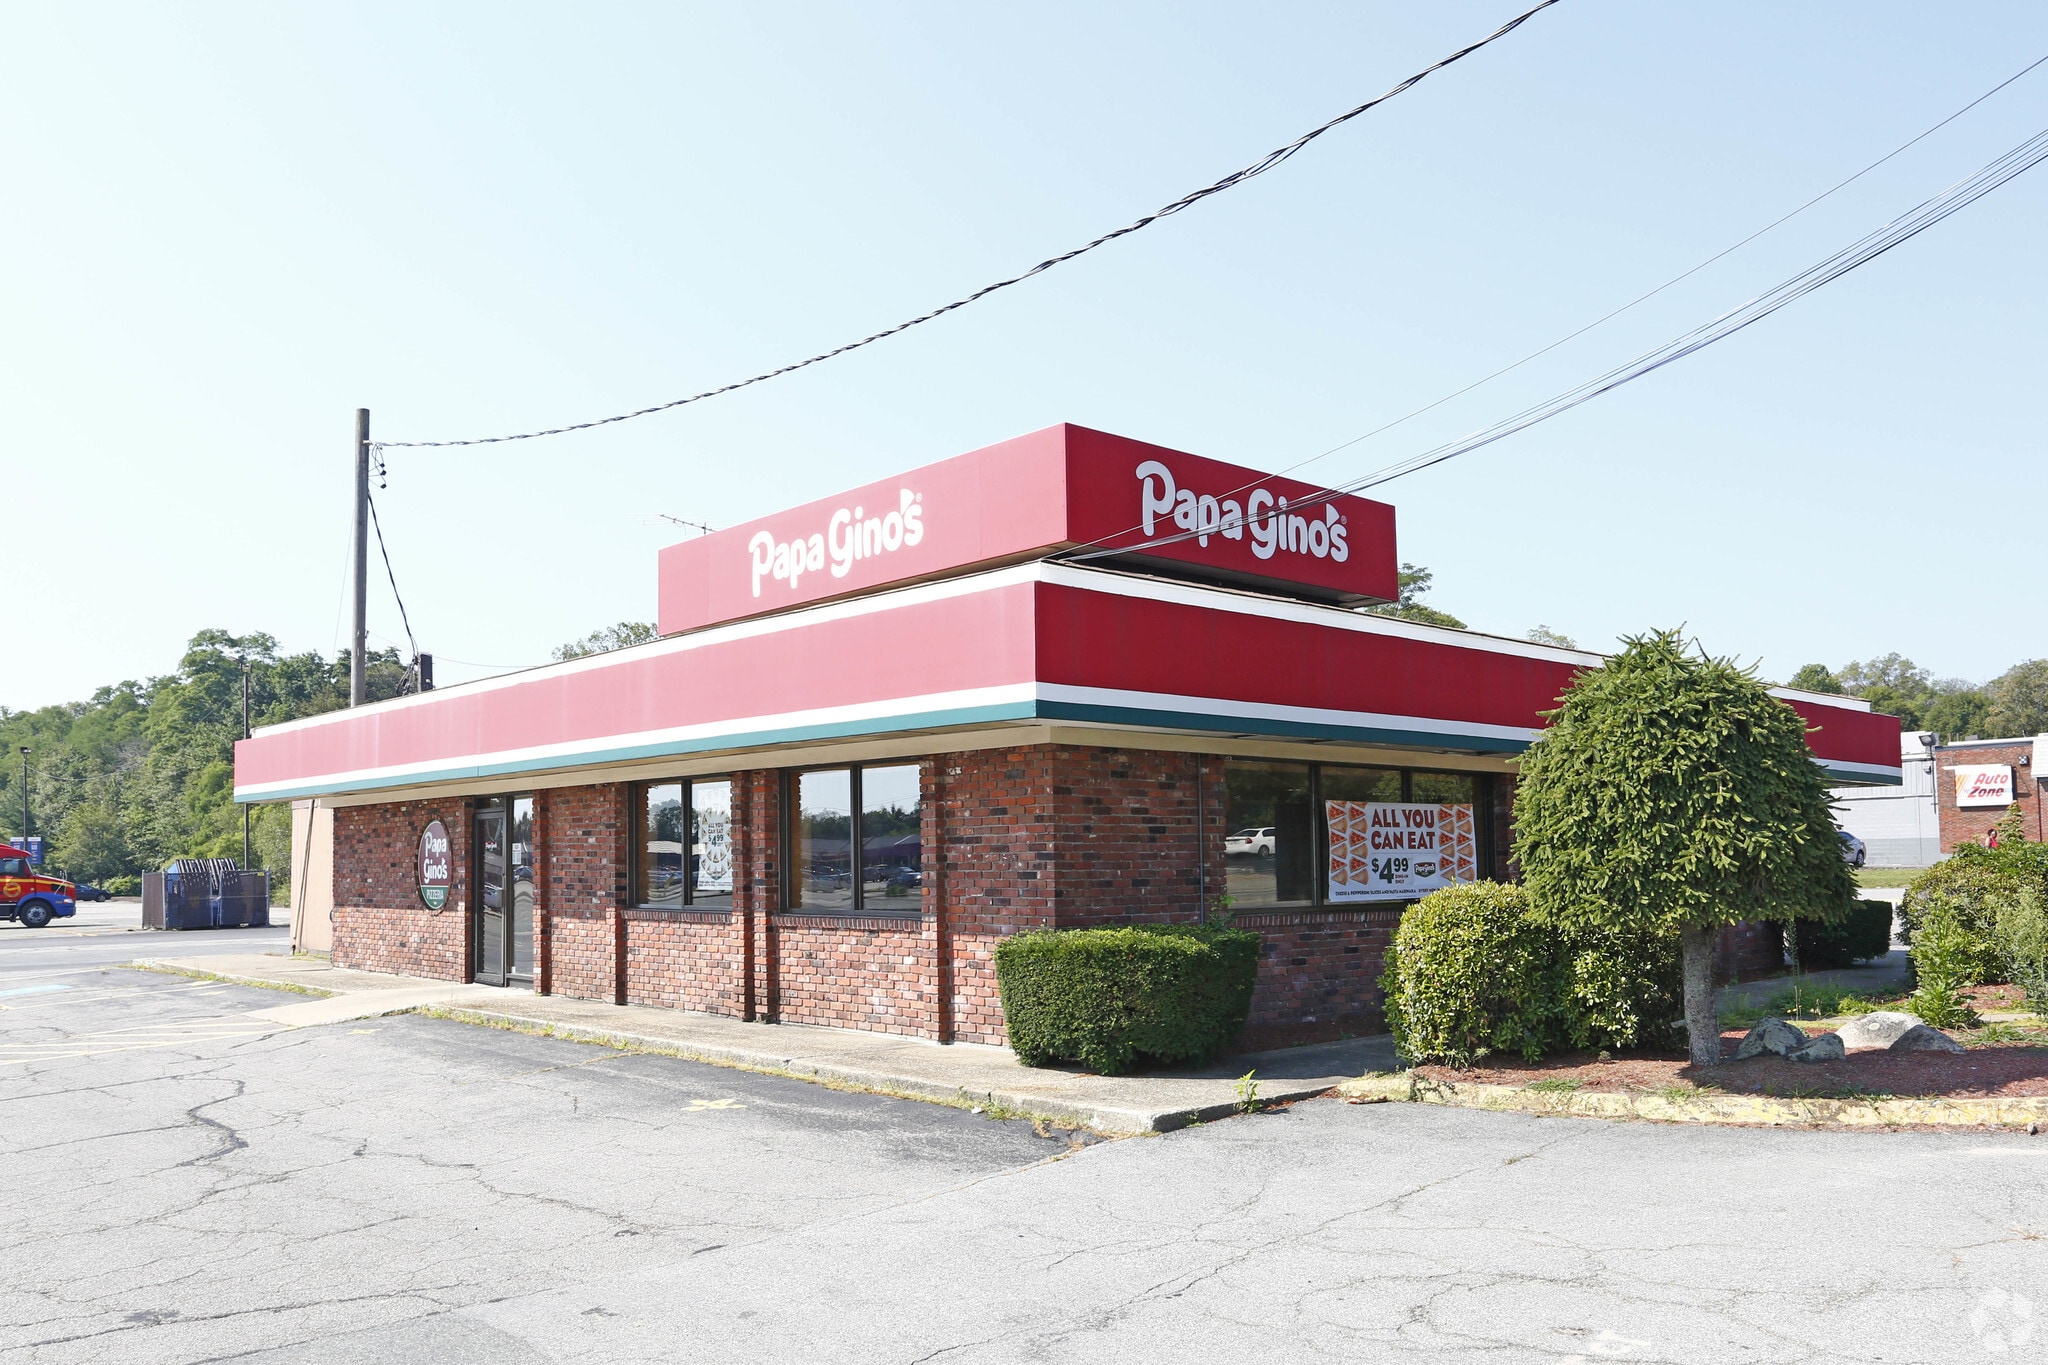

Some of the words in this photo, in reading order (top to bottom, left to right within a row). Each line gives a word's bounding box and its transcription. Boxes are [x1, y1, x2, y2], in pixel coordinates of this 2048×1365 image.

[1135, 460, 1243, 548] Papa
[1248, 488, 1349, 563] Gino's
[748, 530, 825, 598] Papa
[828, 488, 924, 578] Gino's
[1974, 773, 2009, 785] Auto
[1967, 786, 2004, 798] Zone
[1371, 809, 1400, 828] ALL
[1401, 809, 1435, 828] YOU
[424, 832, 447, 857] Papa
[1371, 831, 1404, 850] CAN
[1407, 832, 1435, 849] EAT
[423, 857, 448, 884] Gino's
[426, 889, 444, 899] PIZZERIA
